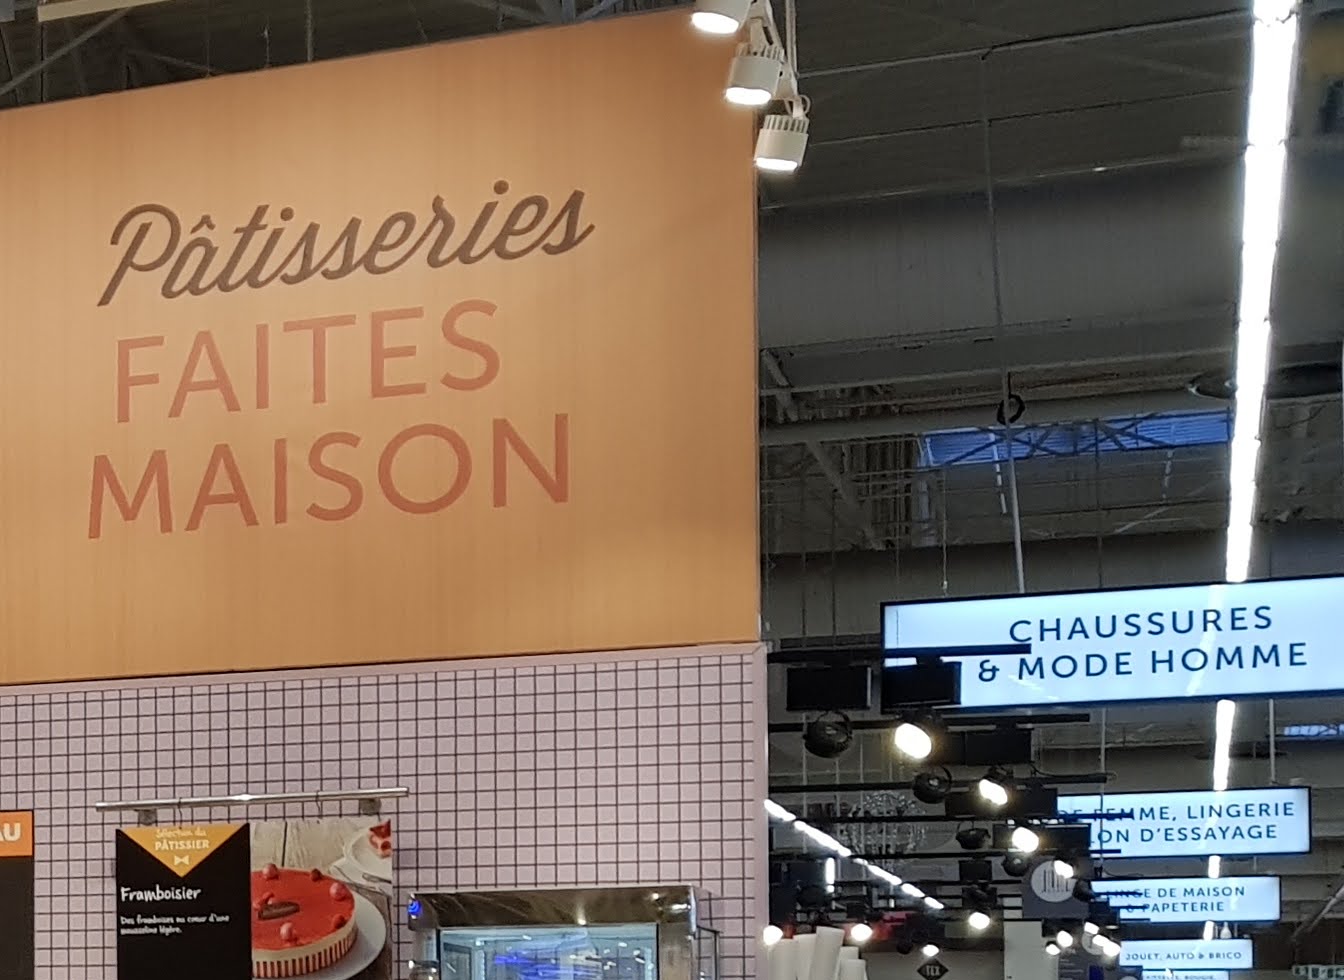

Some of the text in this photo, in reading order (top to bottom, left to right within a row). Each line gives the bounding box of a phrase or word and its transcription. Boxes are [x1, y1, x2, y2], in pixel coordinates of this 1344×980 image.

[96, 179, 596, 307] Pâtisseries
[116, 298, 500, 424] FAITES
[88, 412, 569, 540] MAISON
[1009, 605, 1274, 643] CHAUSSURES
[977, 641, 1309, 683] & MODE HOMME
[1187, 801, 1295, 820] LINGERIE
[1140, 824, 1278, 843] D'ESSAYAGE
[155, 838, 209, 850] PÂTISSIER
[120, 884, 202, 902] Framboisier
[1157, 887, 1177, 898] DE
[1183, 885, 1245, 898] MAISON
[1166, 952, 1195, 960] AUTO
[1209, 951, 1242, 960] BRICO
